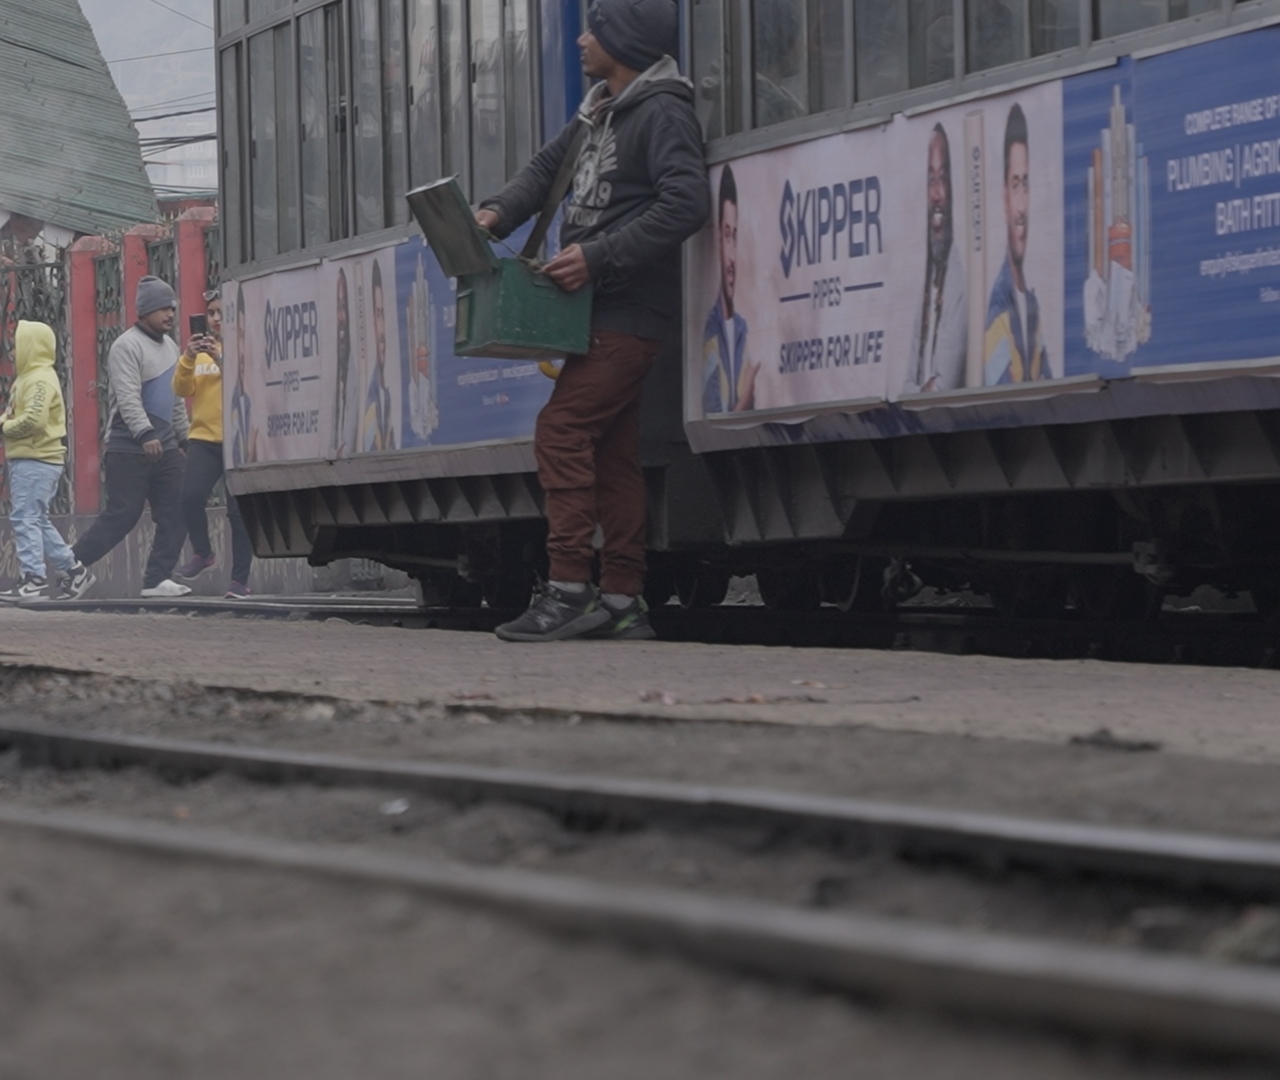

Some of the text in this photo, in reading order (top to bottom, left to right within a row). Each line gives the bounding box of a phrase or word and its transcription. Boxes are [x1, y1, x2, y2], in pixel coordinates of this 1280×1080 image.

[1184, 105, 1231, 136] COMPLETE
[1232, 98, 1265, 125] RANGE
[1166, 148, 1234, 193] PLUMBING
[780, 176, 883, 279] SKIPPER
[1215, 198, 1251, 236] BATH
[813, 276, 842, 310] PIPES
[264, 299, 320, 370] SKIPPER
[779, 330, 884, 375] SKIPPER FOR LIFE
